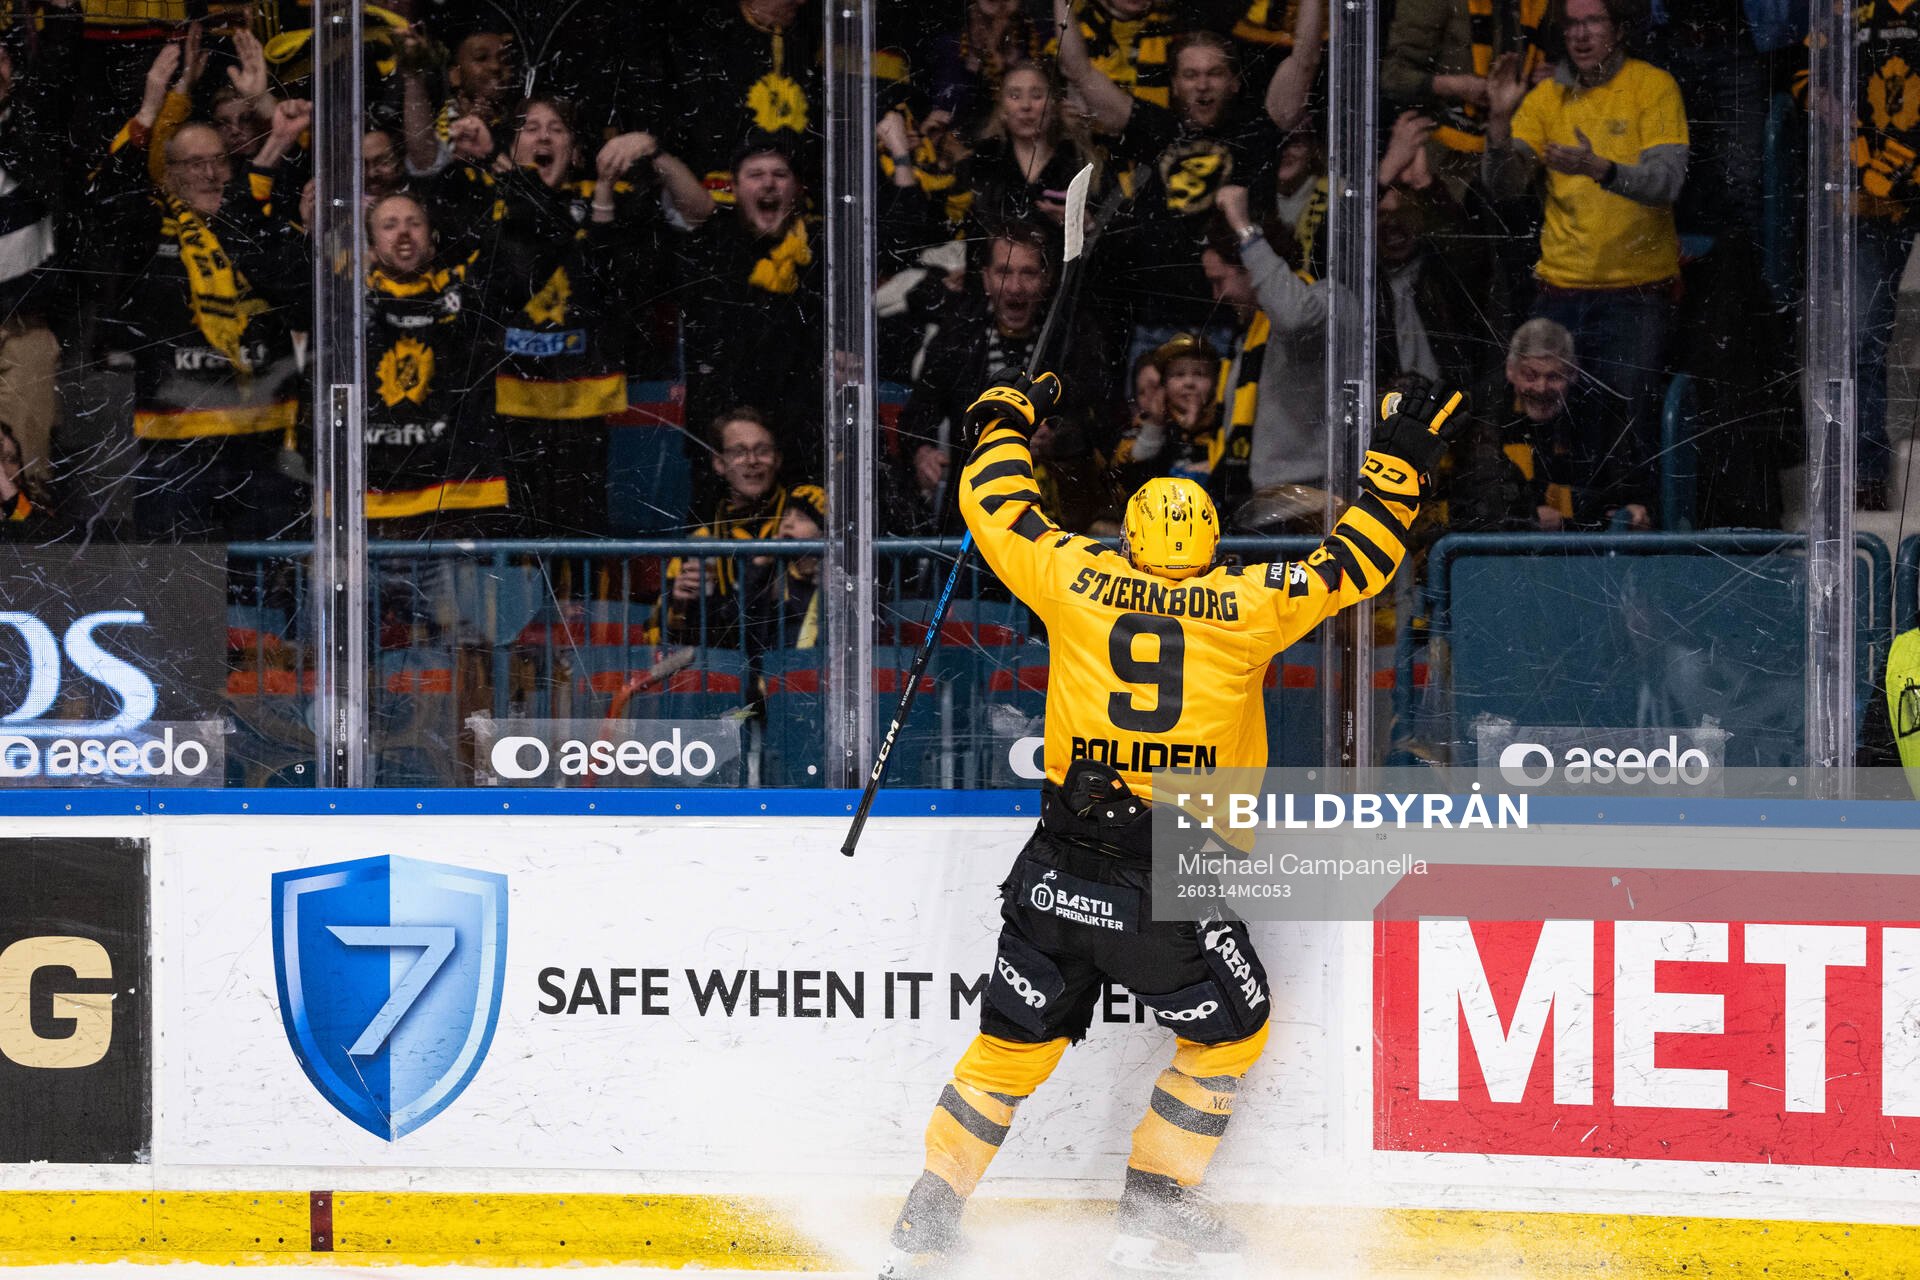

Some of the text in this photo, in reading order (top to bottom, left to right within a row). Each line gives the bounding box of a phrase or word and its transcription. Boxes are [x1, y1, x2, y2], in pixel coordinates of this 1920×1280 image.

[1175, 541, 1183, 551] 9
[1069, 567, 1240, 622] STJERNBORG
[1108, 612, 1185, 734] 9
[50, 727, 209, 776] asedo
[559, 727, 716, 777] asedo
[871, 719, 900, 781] CCM
[1071, 736, 1217, 776] BOLIDEN
[1563, 735, 1710, 786] asedo
[1055, 906, 1124, 932] PRODUKTER
[1056, 889, 1113, 917] BASTU
[537, 966, 671, 1016] SAFE
[685, 968, 865, 1019] WHEN
[884, 972, 933, 1020] IT
